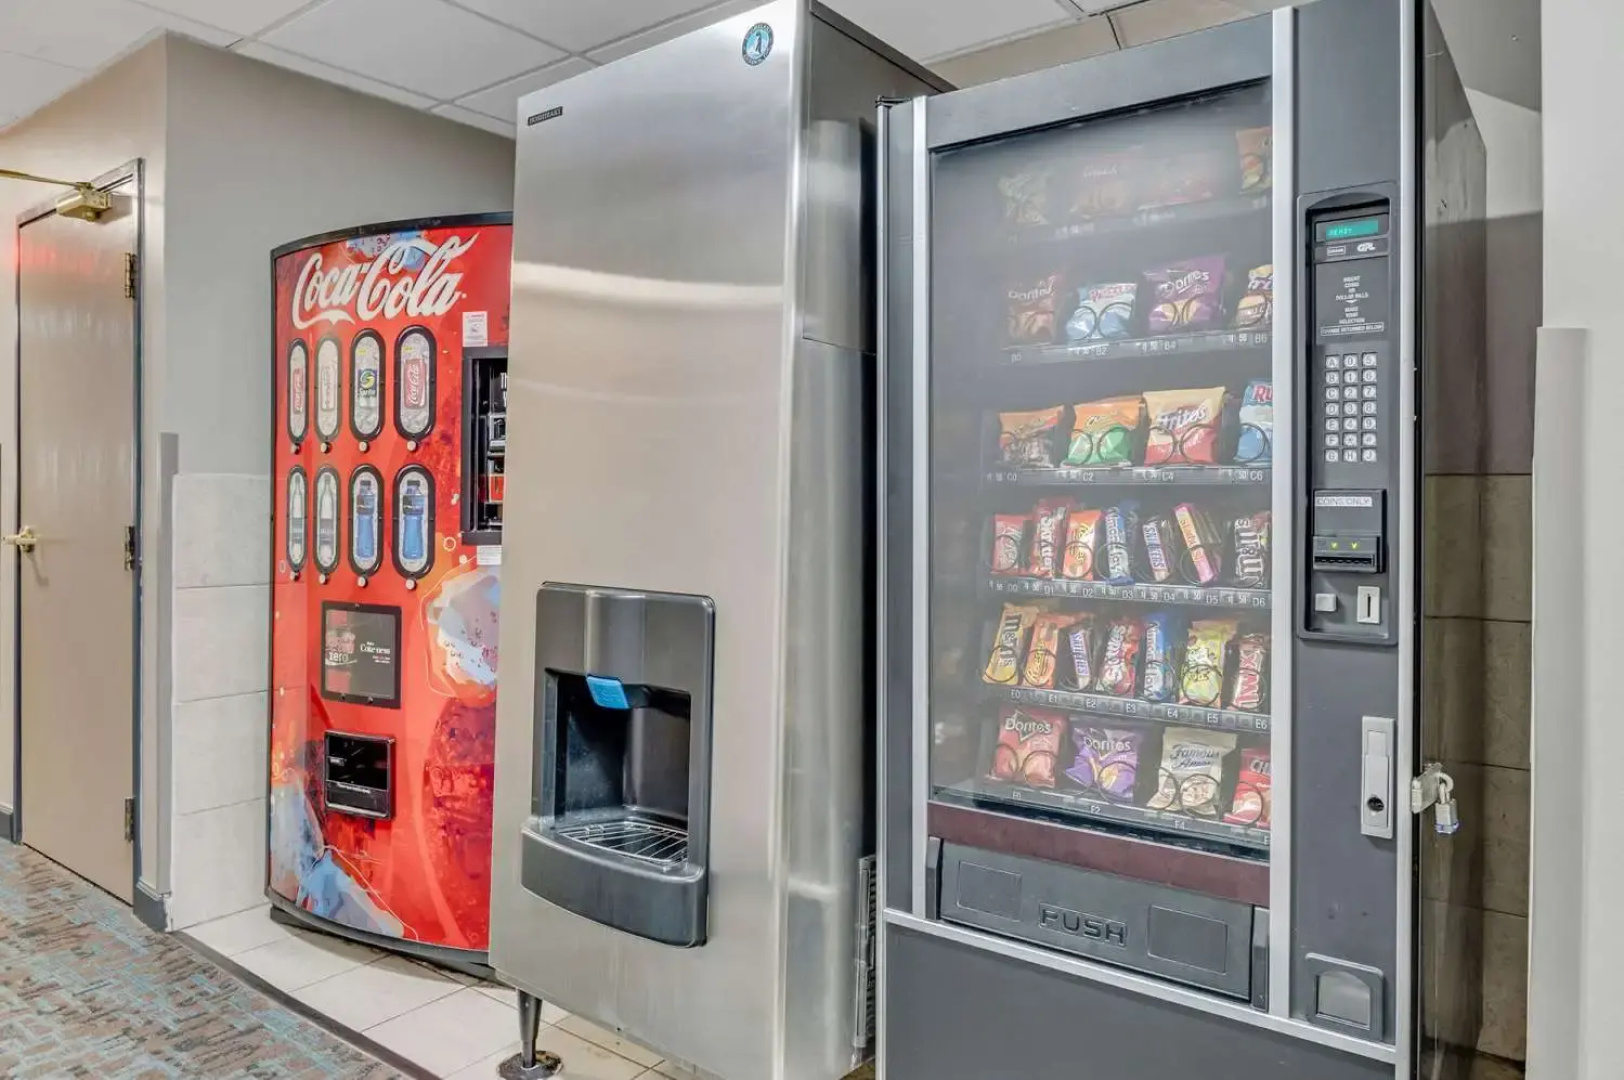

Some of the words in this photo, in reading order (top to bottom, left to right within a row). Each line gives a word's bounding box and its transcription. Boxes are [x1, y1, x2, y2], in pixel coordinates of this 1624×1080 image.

[292, 232, 481, 330] Coca-Cola
[1082, 472, 1094, 482] C2
[1252, 597, 1265, 607] D6
[1207, 712, 1218, 724] E5
[1255, 718, 1268, 730] E6
[1004, 718, 1052, 734] Doritos
[1083, 736, 1131, 752] Doritos
[1040, 908, 1126, 946] PUSH
